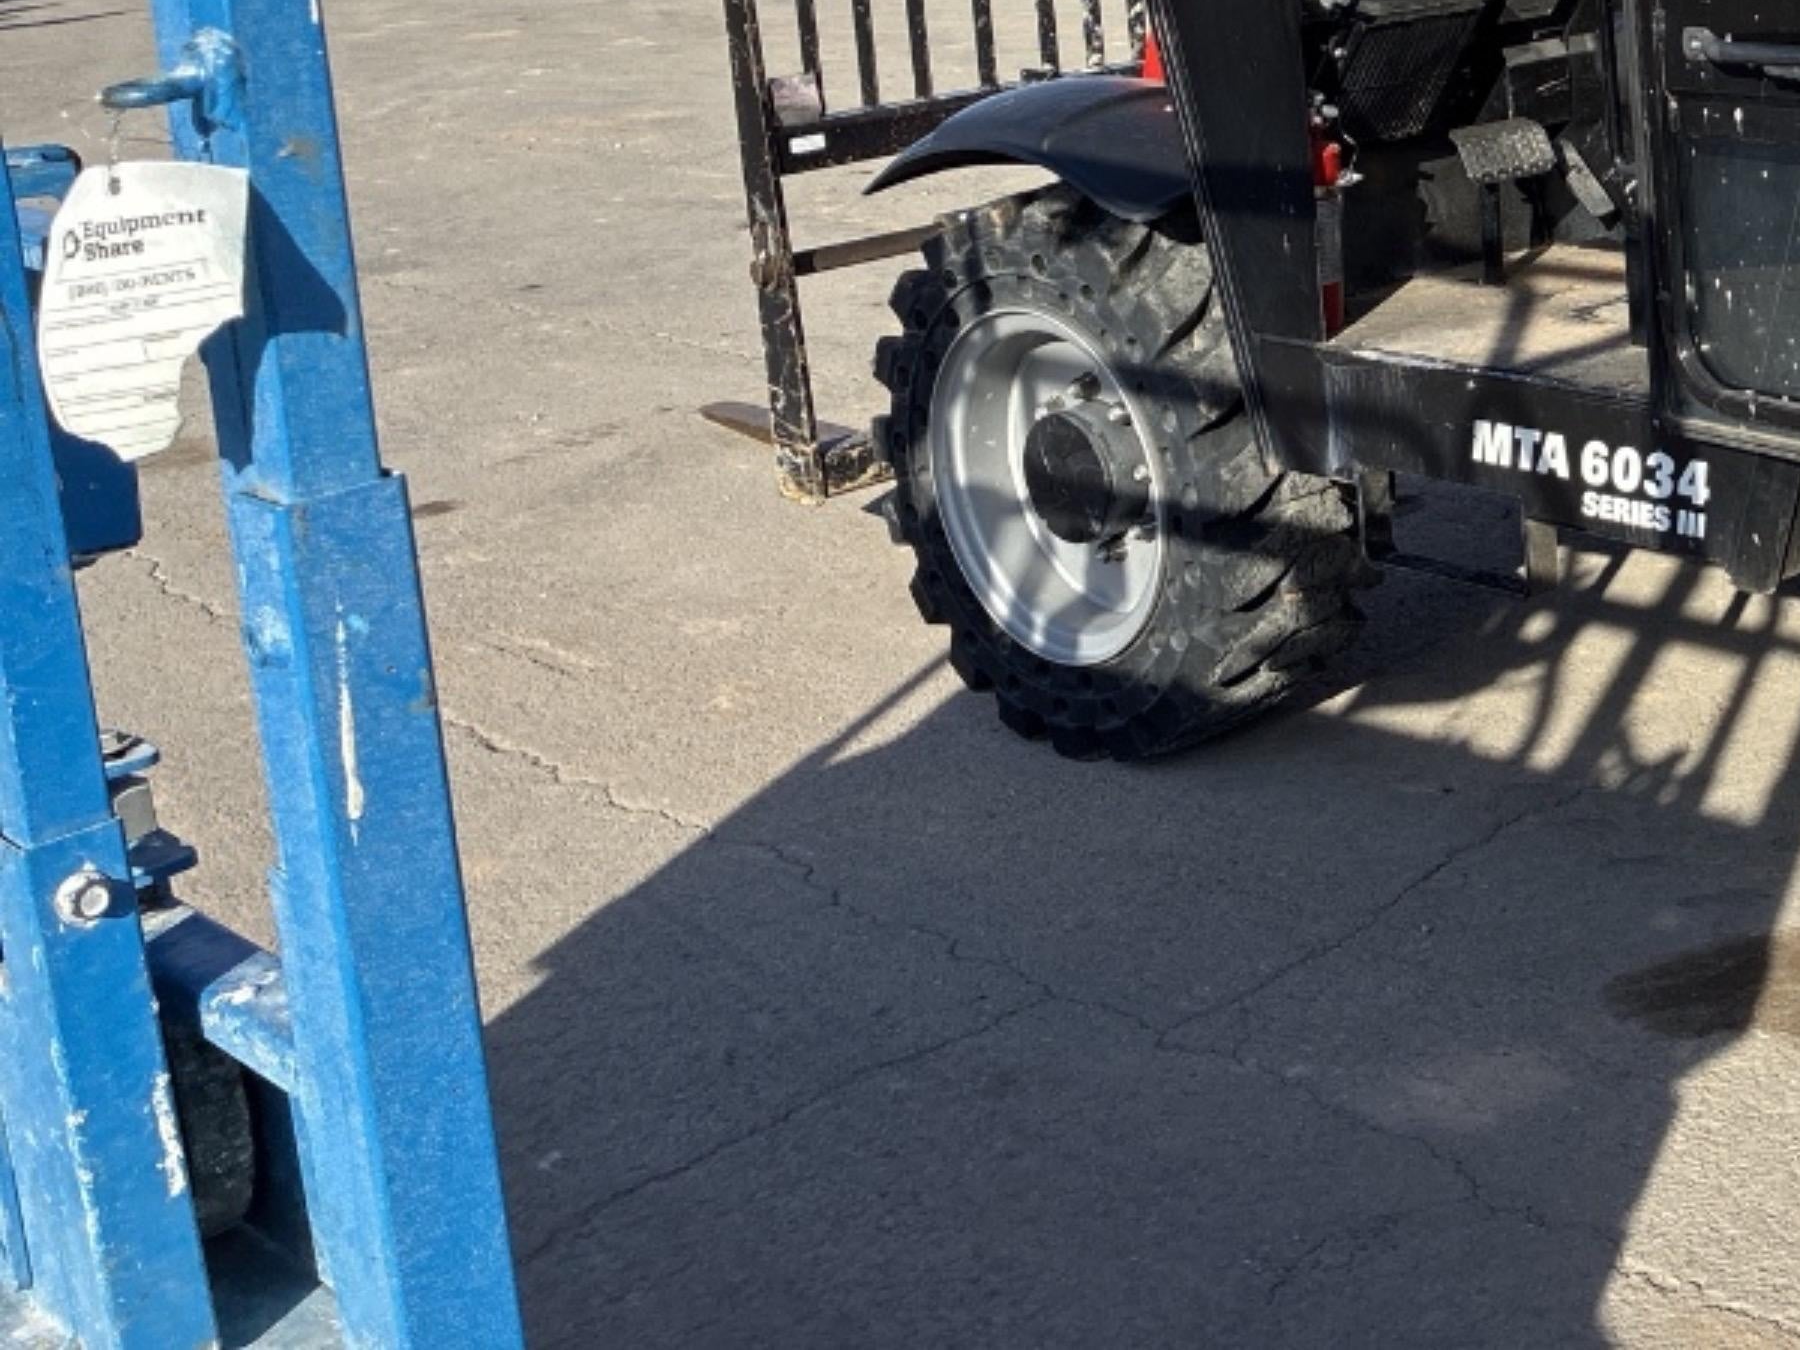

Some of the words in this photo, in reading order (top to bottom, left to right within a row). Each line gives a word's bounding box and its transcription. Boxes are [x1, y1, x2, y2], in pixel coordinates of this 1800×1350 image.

[80, 209, 206, 239] Equipment
[84, 240, 145, 261] Share
[1471, 419, 1570, 480] MTA
[1579, 439, 1711, 506] 6034
[1580, 490, 1671, 533] SERIES
[1676, 509, 1706, 540] III
